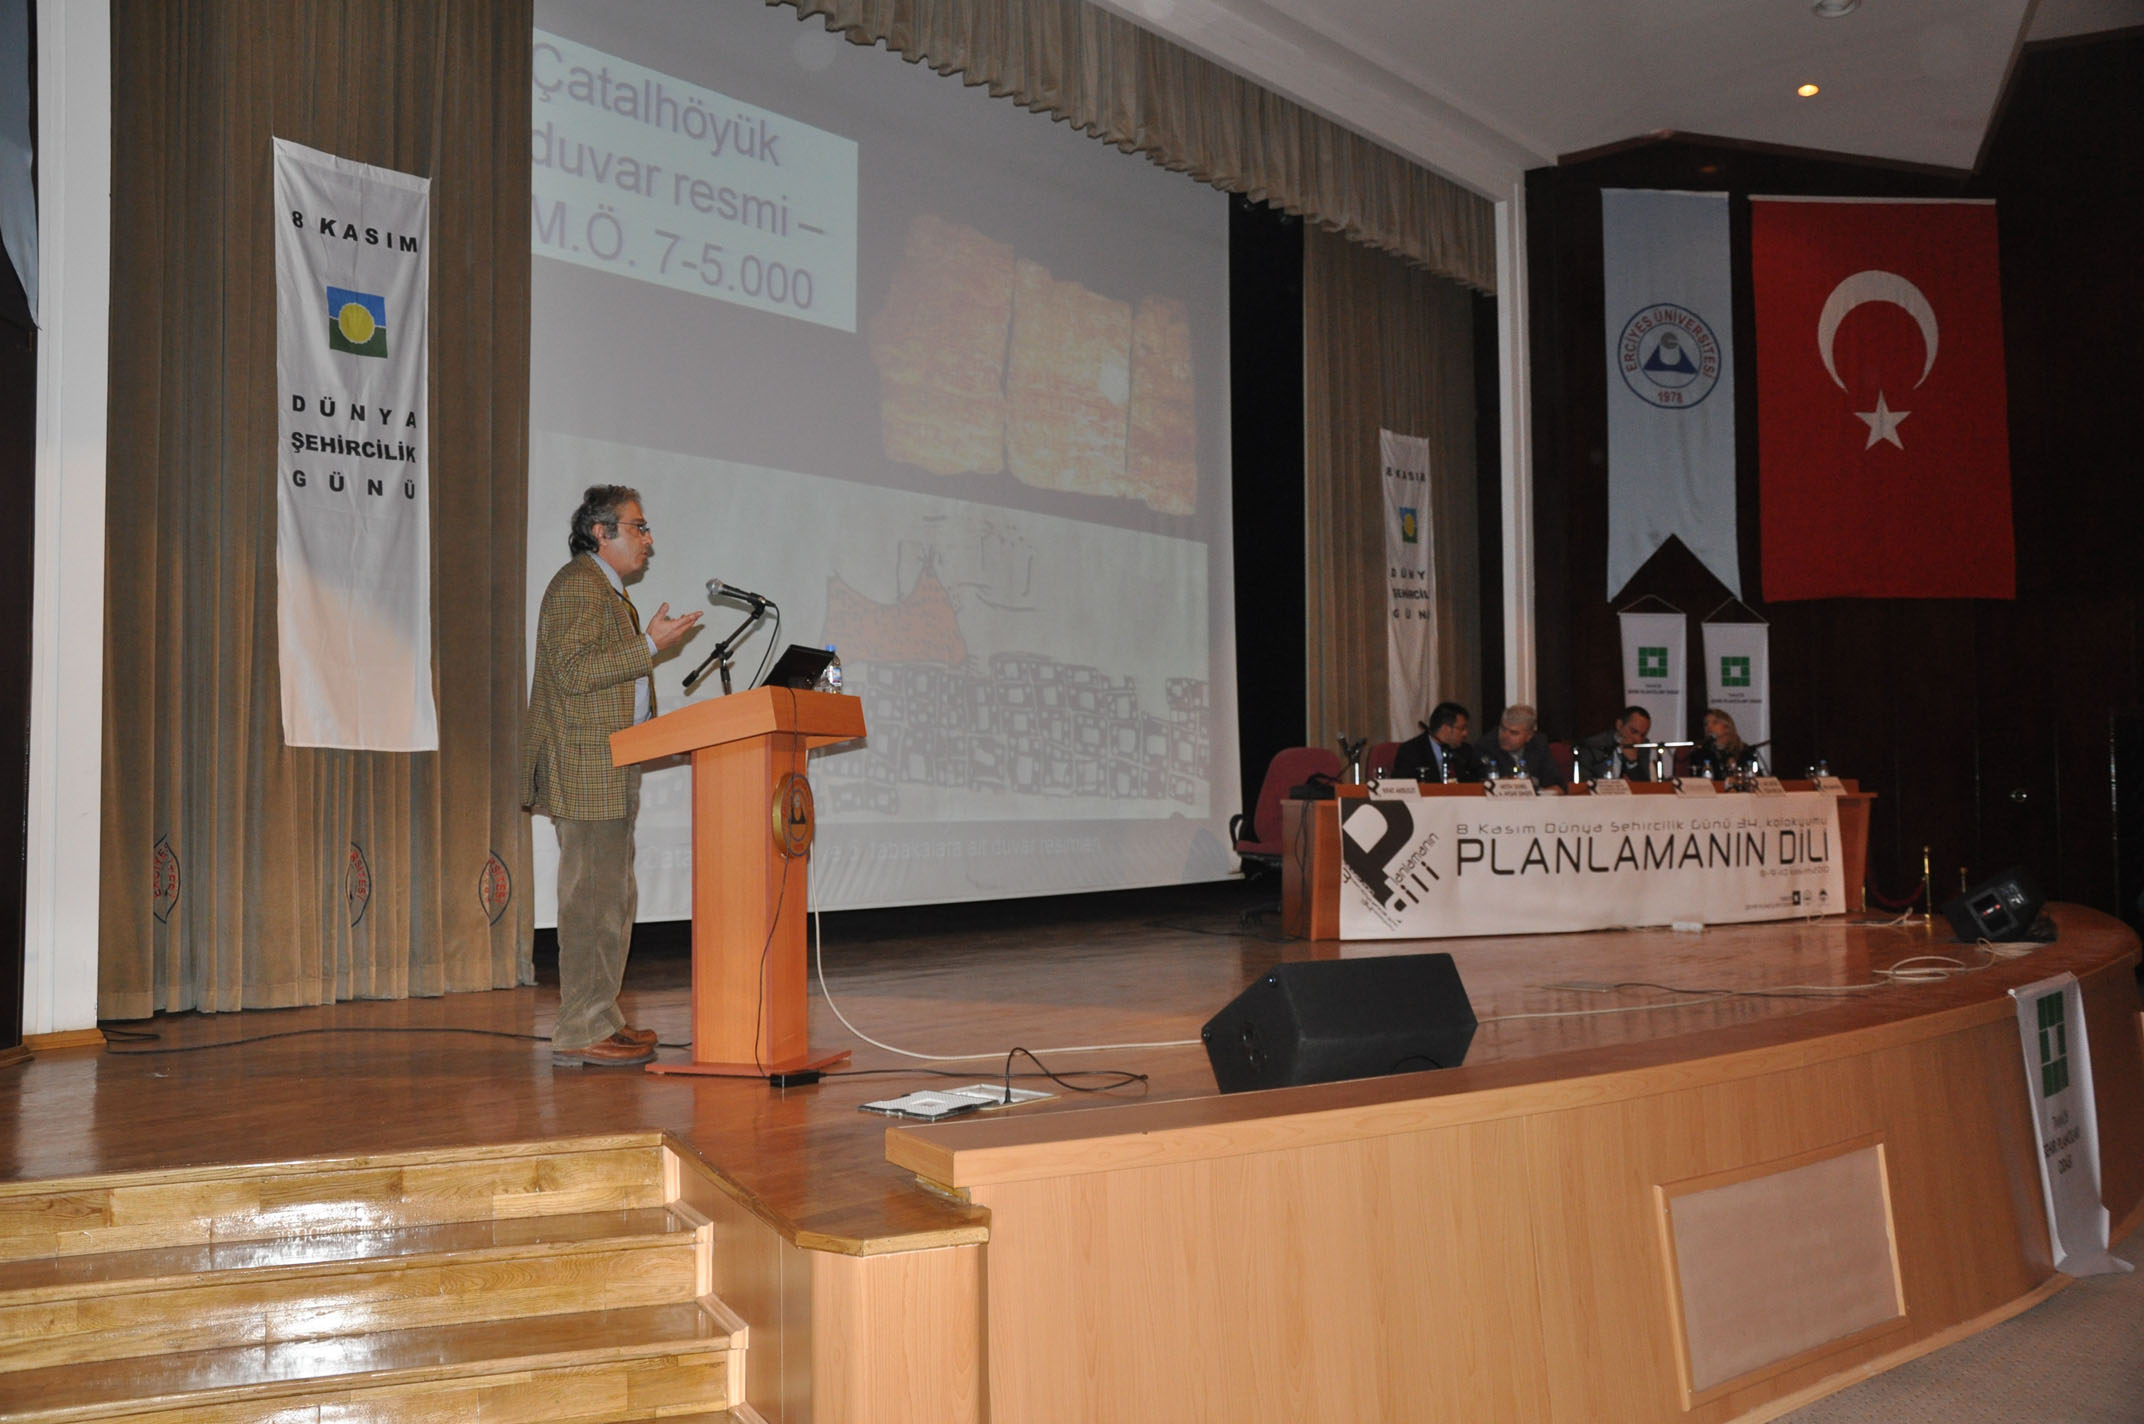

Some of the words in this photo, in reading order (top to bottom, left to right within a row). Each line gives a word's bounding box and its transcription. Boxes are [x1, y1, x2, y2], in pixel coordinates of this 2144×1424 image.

[532, 43, 780, 167] Çatalhöyük
[531, 121, 662, 198] duvar
[674, 172, 788, 237] resmi
[291, 211, 304, 229] 8
[320, 217, 419, 253] KASIM
[291, 394, 417, 429] DÜNYA
[1657, 390, 1684, 404] 1978
[291, 431, 417, 463] ŞEHİRCİLİK
[292, 469, 416, 500] GÜNÜ
[1545, 822, 1603, 835] Dünya
[1457, 831, 1765, 877] PLANLAMANIN
